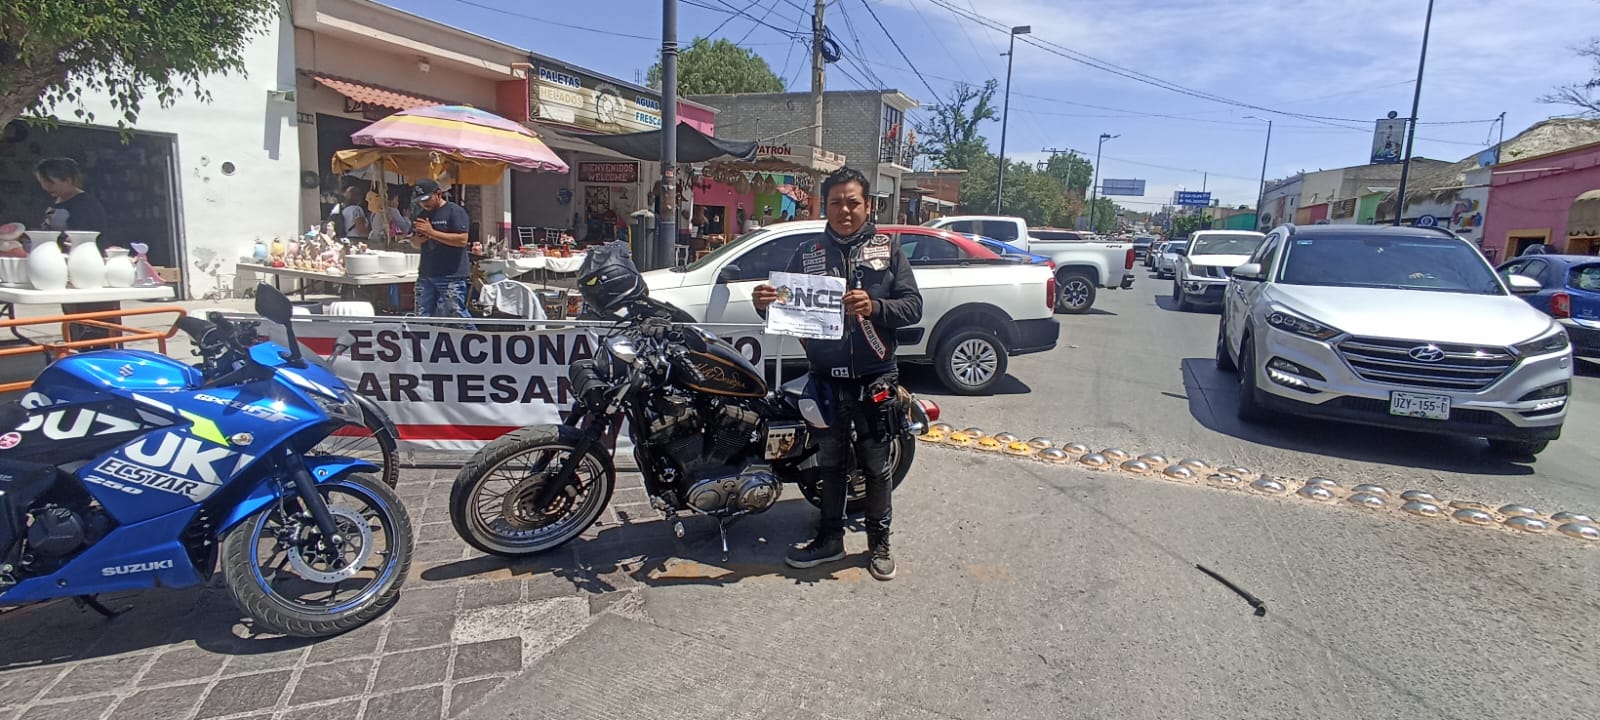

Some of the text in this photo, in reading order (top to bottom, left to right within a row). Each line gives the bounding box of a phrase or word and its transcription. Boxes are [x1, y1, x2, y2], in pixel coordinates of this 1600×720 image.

[540, 68, 580, 88] PALETAS
[541, 87, 583, 106] HELADOS
[635, 95, 660, 110] AGUAS
[635, 111, 662, 126] FRESCA
[588, 172, 628, 182] WELCOME
[83, 475, 143, 495] 250
[99, 458, 199, 497] ECSTAR
[102, 559, 173, 576] SUZUKI
